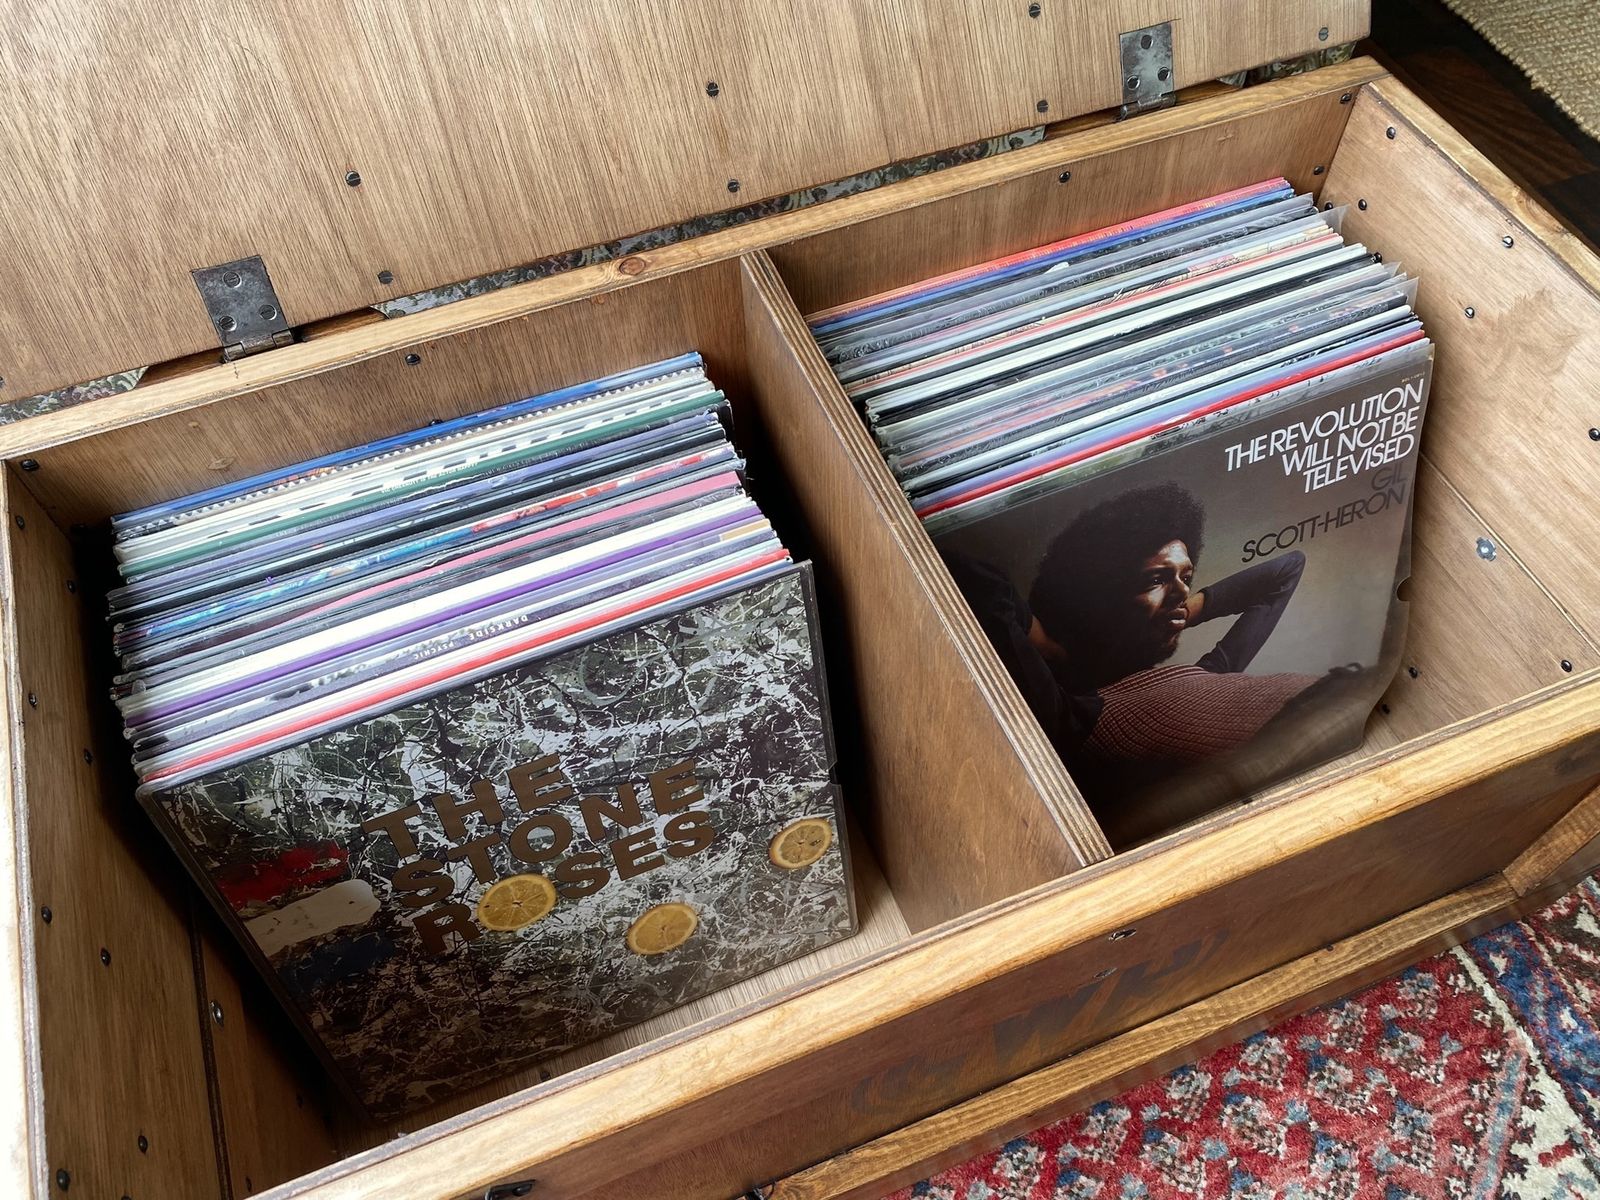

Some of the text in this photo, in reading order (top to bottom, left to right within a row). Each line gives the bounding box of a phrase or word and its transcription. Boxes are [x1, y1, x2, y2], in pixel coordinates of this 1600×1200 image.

[1224, 434, 1267, 471] THE
[1269, 378, 1424, 456] REVOLUTION
[1282, 406, 1421, 476] WILL NOT BE
[1303, 434, 1415, 493] TELEVISED
[1371, 463, 1407, 491] GIL
[1241, 483, 1406, 563] SCOTT-HERON
[414, 614, 529, 660] DARKSIDE PSYCHIC
[361, 754, 573, 859] THE
[391, 758, 704, 908] STONE
